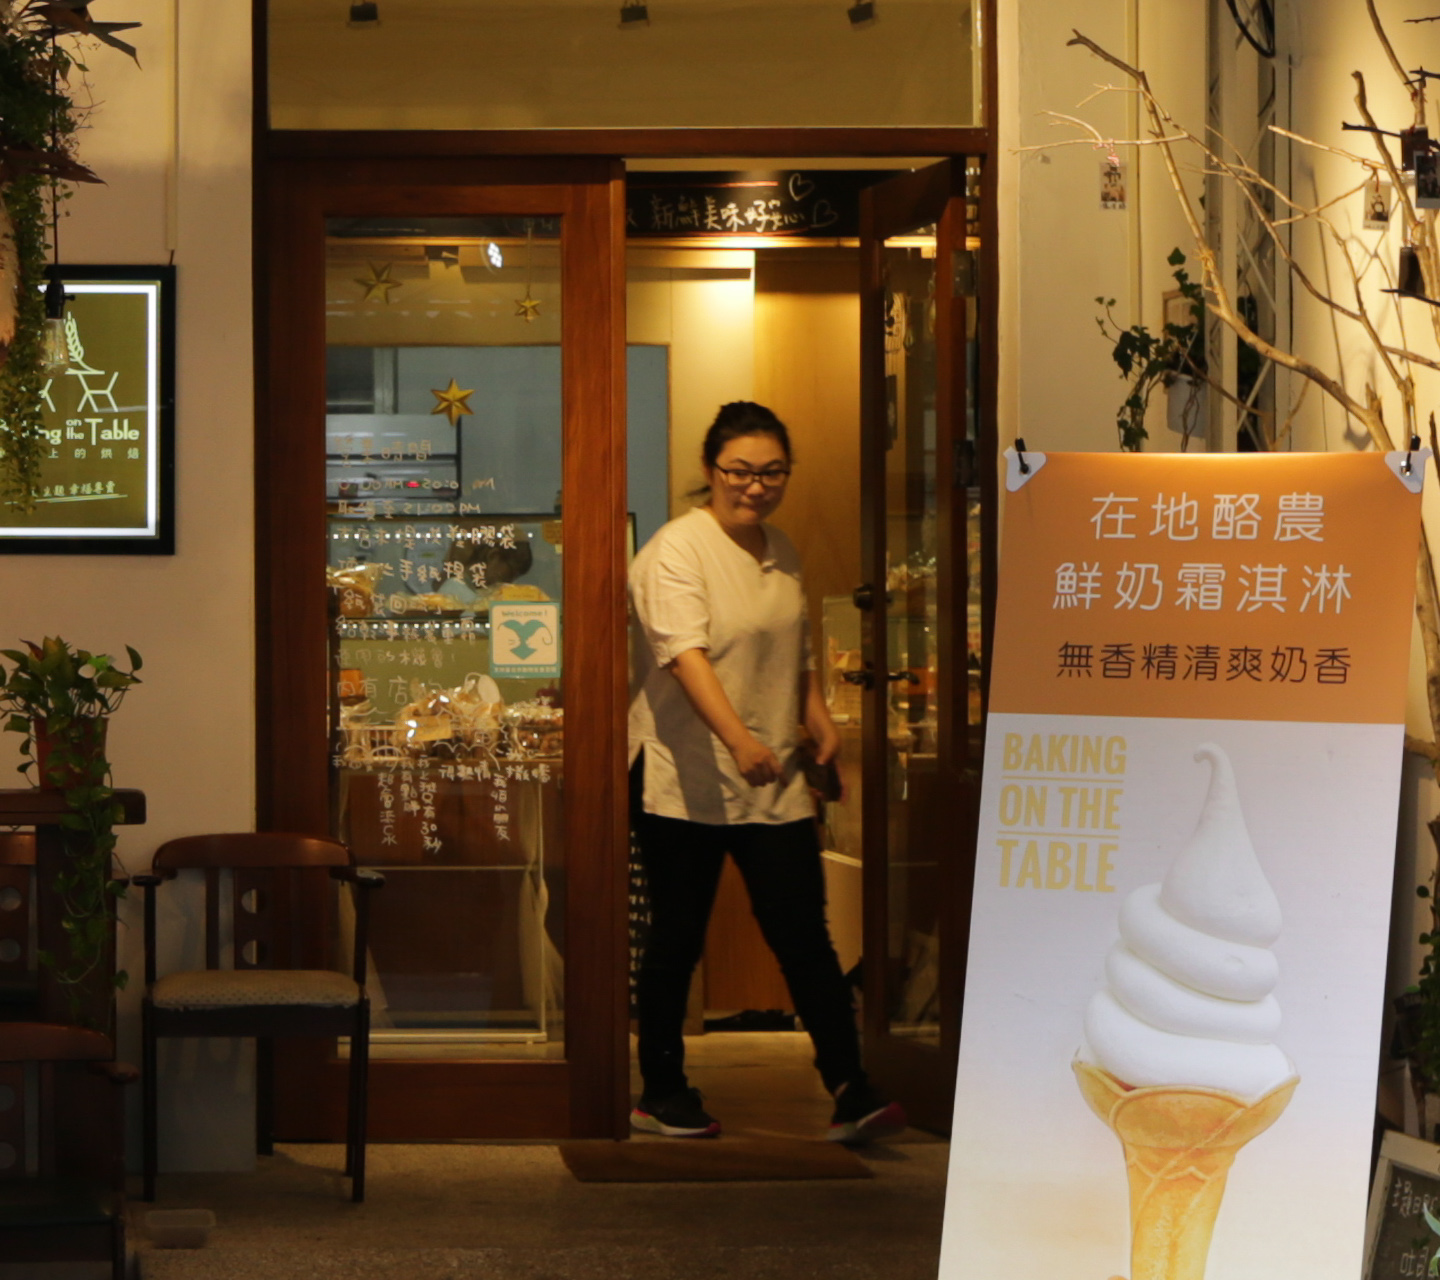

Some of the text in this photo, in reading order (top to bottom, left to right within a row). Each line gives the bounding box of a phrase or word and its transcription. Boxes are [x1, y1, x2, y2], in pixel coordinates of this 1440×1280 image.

[66, 418, 82, 427] on
[66, 426, 85, 440] the
[85, 418, 140, 446] Table
[1090, 492, 1325, 543] 在地酪農
[1051, 561, 1352, 616] 鮮奶霜淇淋
[1055, 641, 1352, 686] 無香精清爽奶香
[1001, 732, 1128, 776] BAKING
[998, 783, 1124, 831] ON THE
[996, 838, 1120, 894] TABLE
